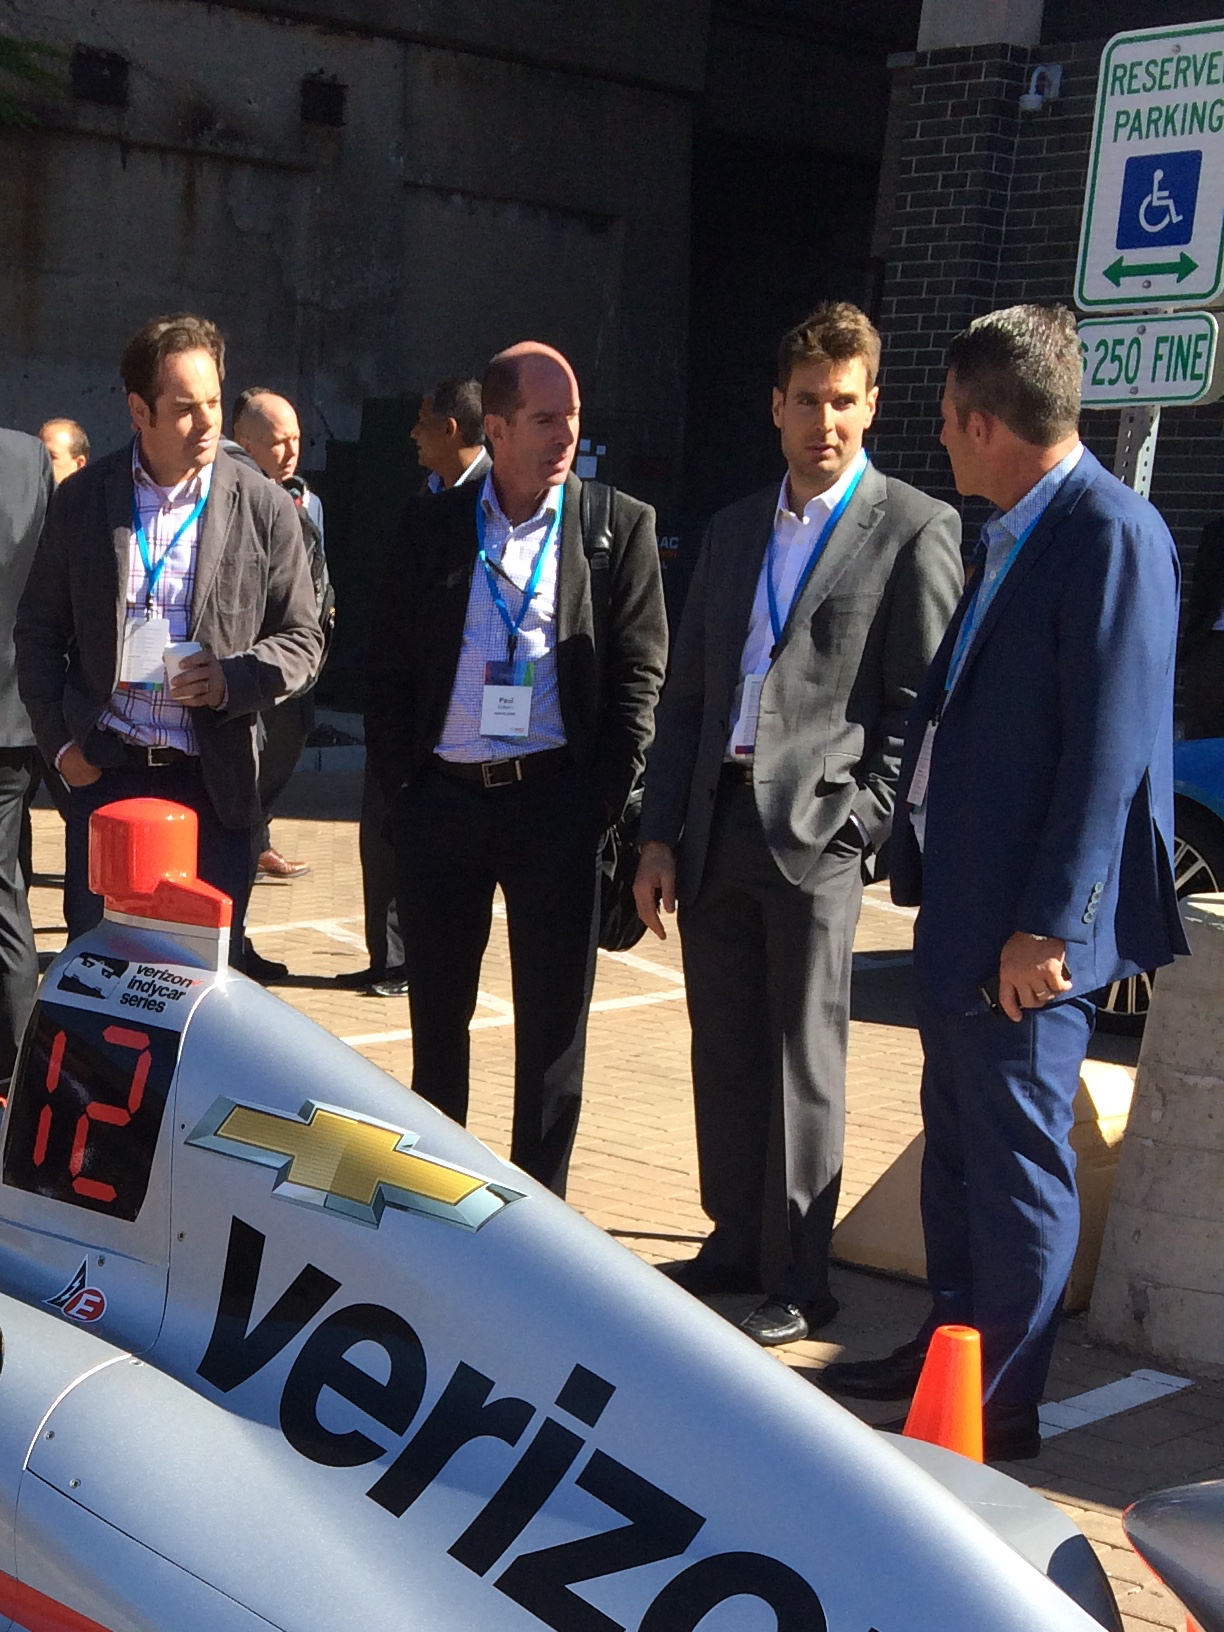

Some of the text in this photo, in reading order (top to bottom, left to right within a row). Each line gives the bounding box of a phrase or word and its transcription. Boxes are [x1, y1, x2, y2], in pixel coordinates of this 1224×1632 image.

[1110, 51, 1224, 96] RESERVE
[1112, 98, 1224, 143] PARKING
[1151, 331, 1209, 383] FINE
[127, 976, 186, 1001] indycar
[135, 964, 193, 988] verizon
[119, 992, 166, 1013] series
[32, 1024, 152, 1202] 12
